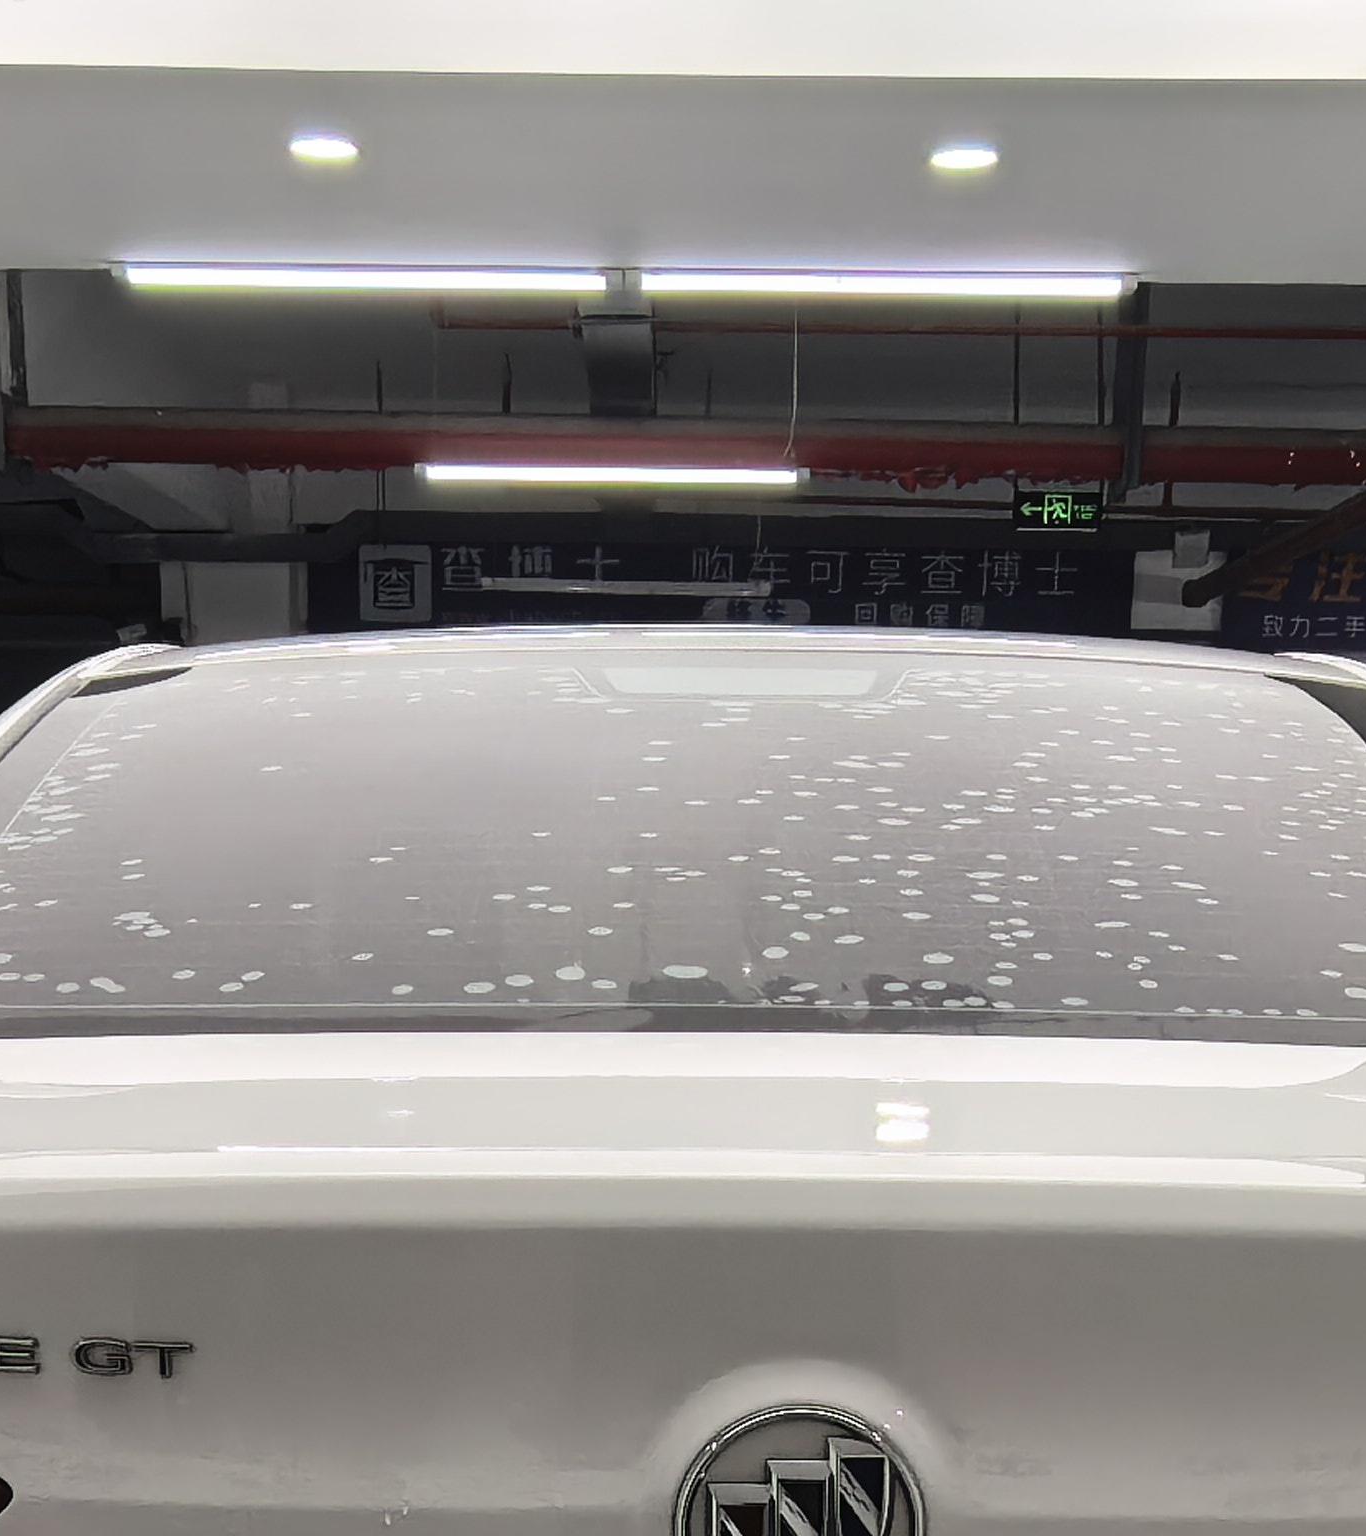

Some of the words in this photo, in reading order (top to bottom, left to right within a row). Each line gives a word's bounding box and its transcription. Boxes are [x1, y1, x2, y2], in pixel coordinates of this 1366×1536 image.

[692, 548, 1078, 597] 购车可享查博士
[72, 1336, 196, 1379] GT
